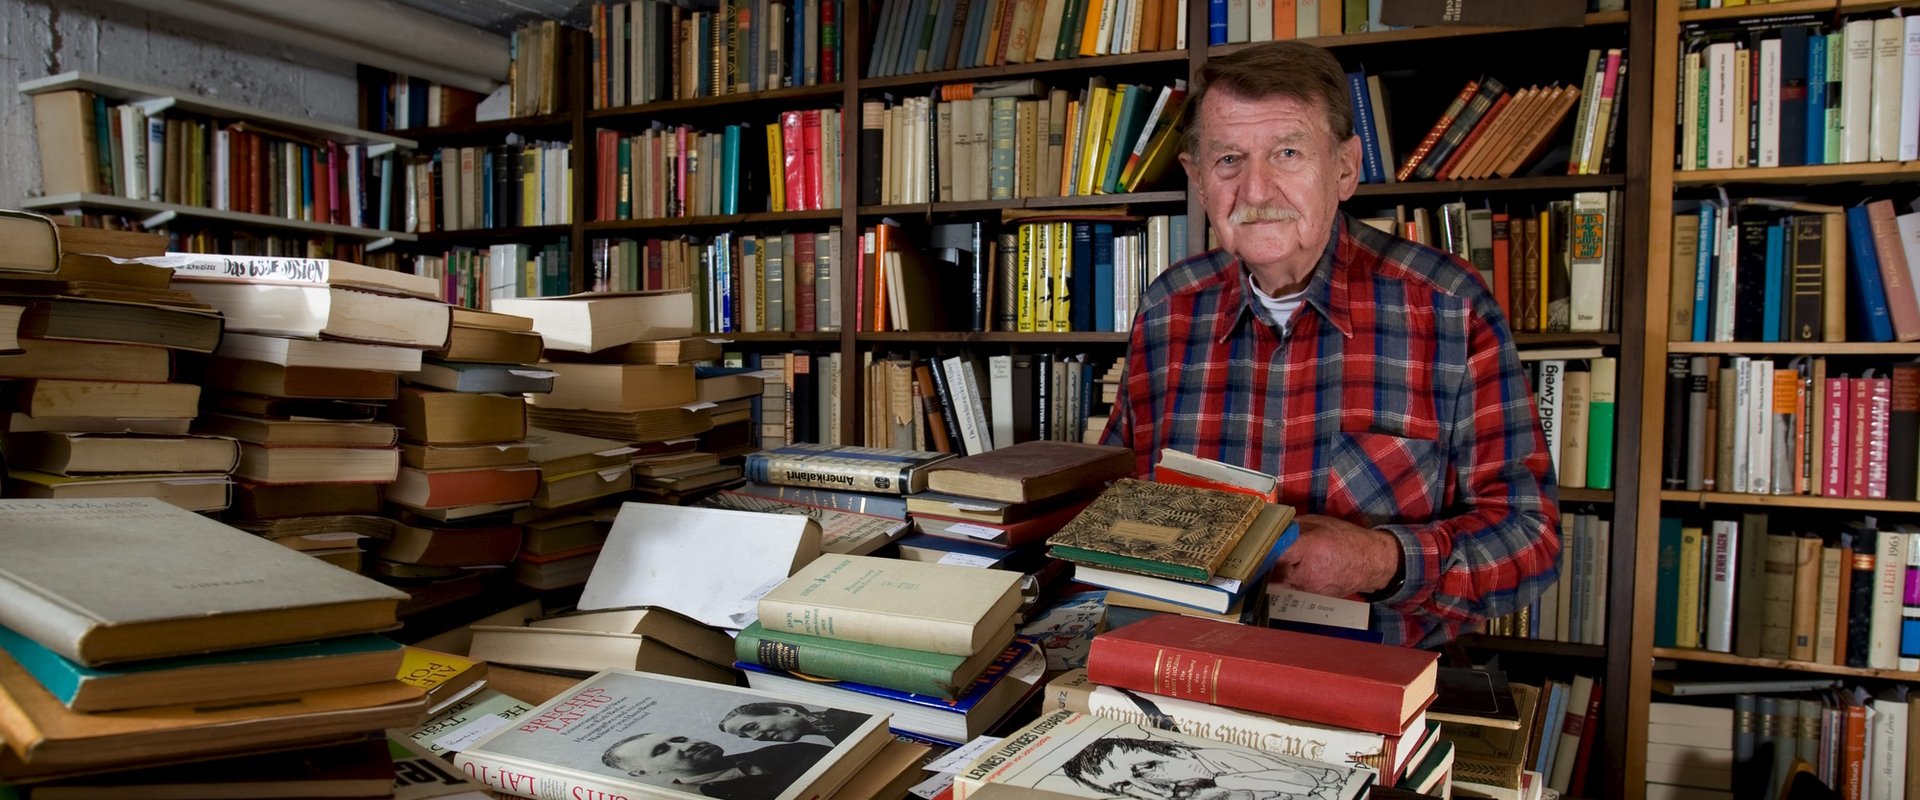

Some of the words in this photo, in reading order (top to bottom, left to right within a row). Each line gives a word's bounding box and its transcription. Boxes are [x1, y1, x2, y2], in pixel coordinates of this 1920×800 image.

[1022, 226, 1030, 255] Jolesch
[224, 259, 245, 276] Das
[1022, 256, 1030, 277] Tante
[1545, 365, 1559, 405] Zweig
[1540, 407, 1554, 447] rnold
[786, 471, 854, 485] Amerikafahrt
[1888, 535, 1900, 557] 1963
[1883, 561, 1896, 595] LIEBE
[786, 612, 794, 628] DER
[804, 609, 812, 633] PUNKT
[422, 665, 456, 687] ALF
[1164, 656, 1174, 689] ALEXANDER
[517, 687, 605, 733] BRECHTS
[543, 694, 612, 732] LAI-TU
[410, 715, 467, 741] Träu
[966, 754, 1006, 781] LEVINES
[1002, 732, 1039, 758] LUSTIGES
[463, 762, 537, 797] LAI-TU
